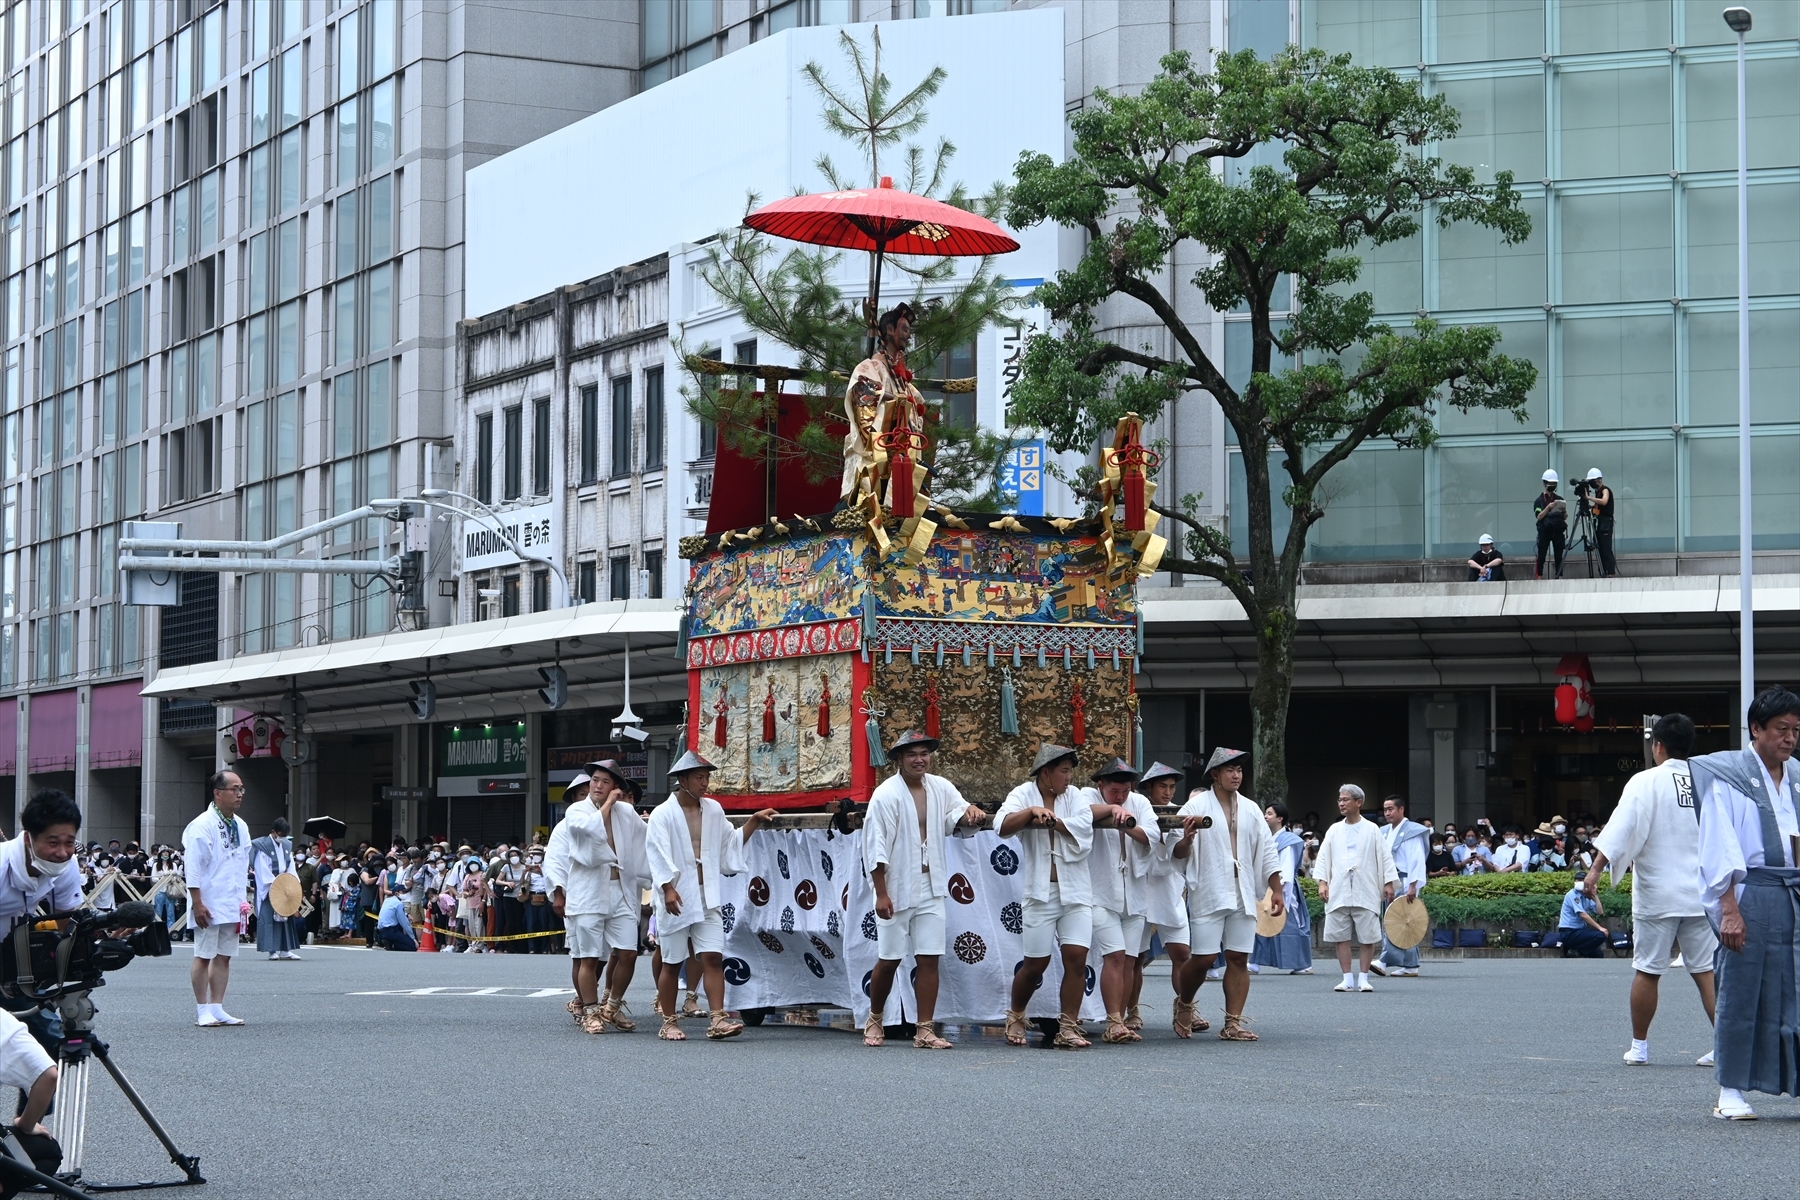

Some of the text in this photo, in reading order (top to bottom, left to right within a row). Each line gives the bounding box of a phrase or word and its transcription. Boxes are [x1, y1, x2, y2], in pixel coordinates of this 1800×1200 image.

[1021, 448, 1037, 489] すぐ
[466, 518, 550, 558] MARUMARU 雲の茶
[447, 738, 499, 766] MARUMARU
[503, 736, 527, 763] 雲の茶
[632, 766, 648, 777] TICKET
